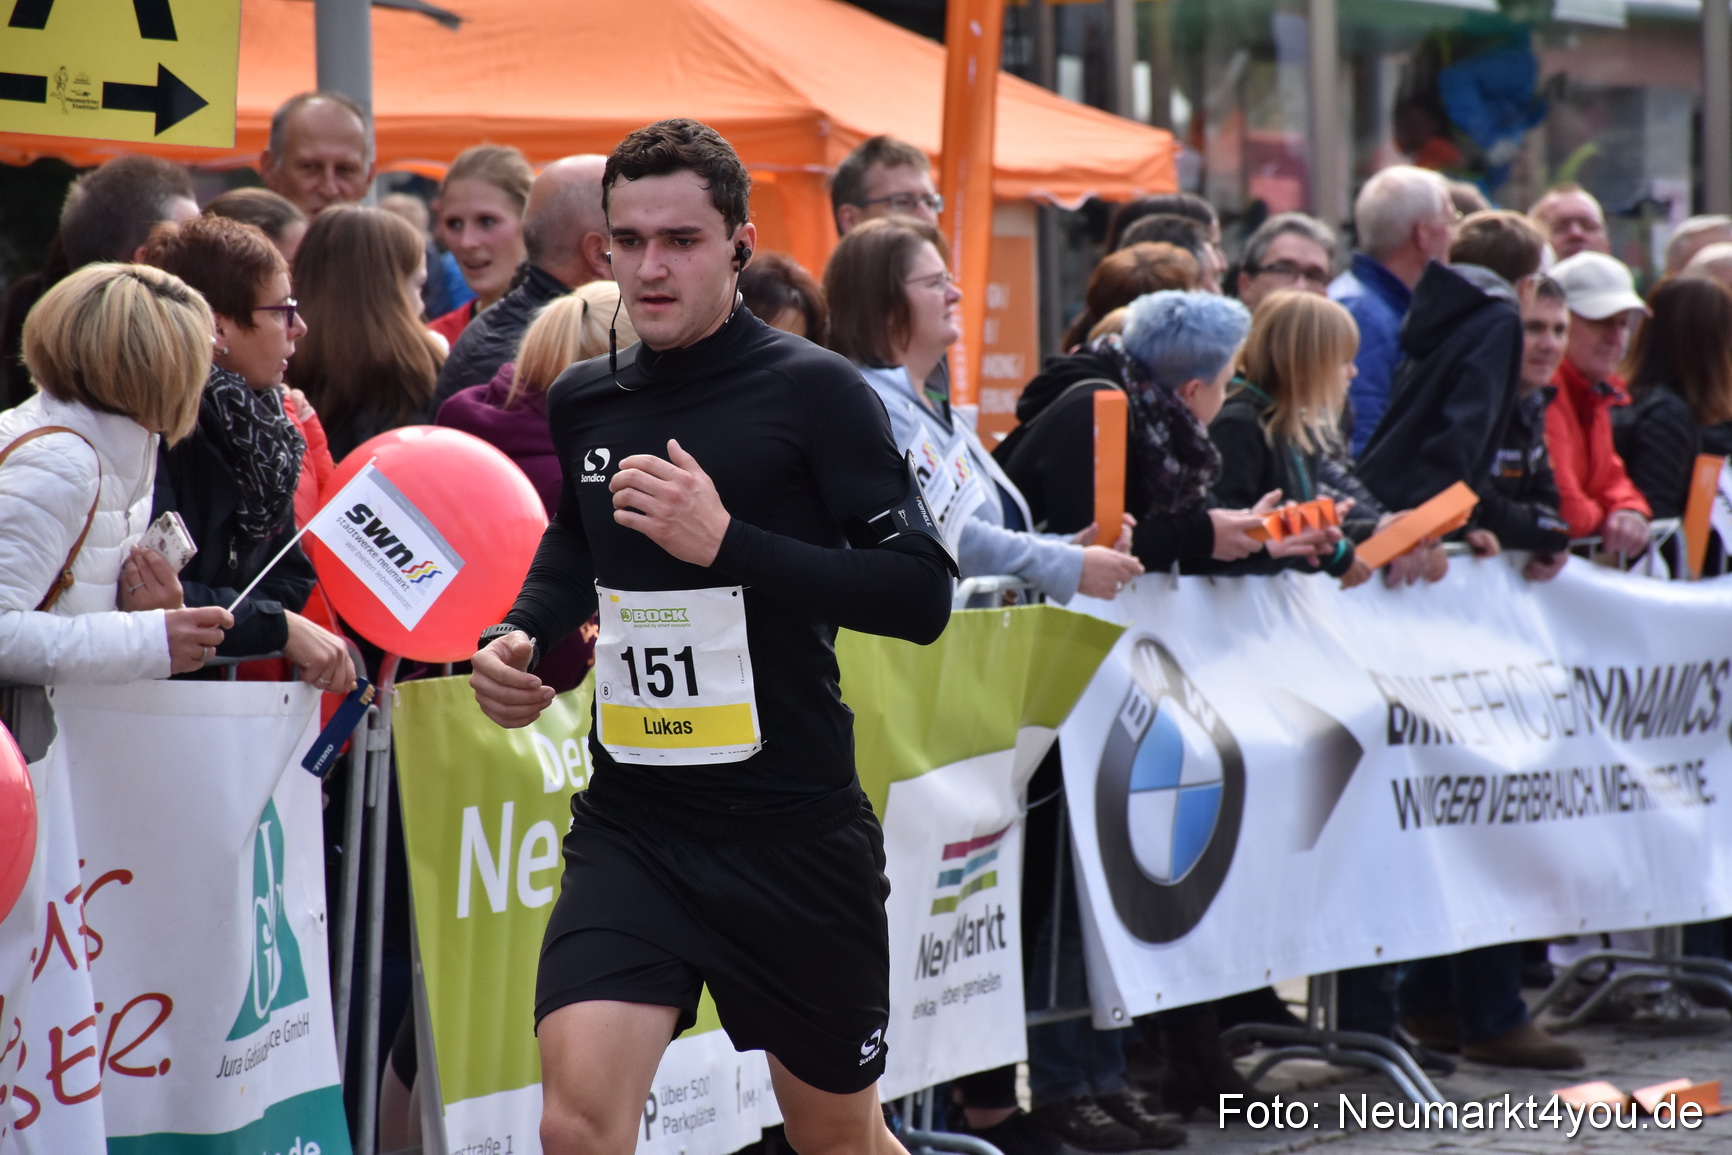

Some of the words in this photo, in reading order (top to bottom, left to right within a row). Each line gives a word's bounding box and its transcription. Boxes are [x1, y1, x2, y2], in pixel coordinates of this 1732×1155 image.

[335, 516, 380, 559] stadtwerke
[377, 557, 410, 592] neumarkt
[344, 503, 414, 569] swn
[632, 608, 689, 622] BOCK
[603, 686, 609, 696] B
[621, 646, 699, 698] 151
[643, 717, 693, 735] Lukas
[457, 800, 575, 919] Ne
[216, 1055, 244, 1079] Jura
[283, 1012, 310, 1043] GmbH
[660, 1085, 689, 1107] über
